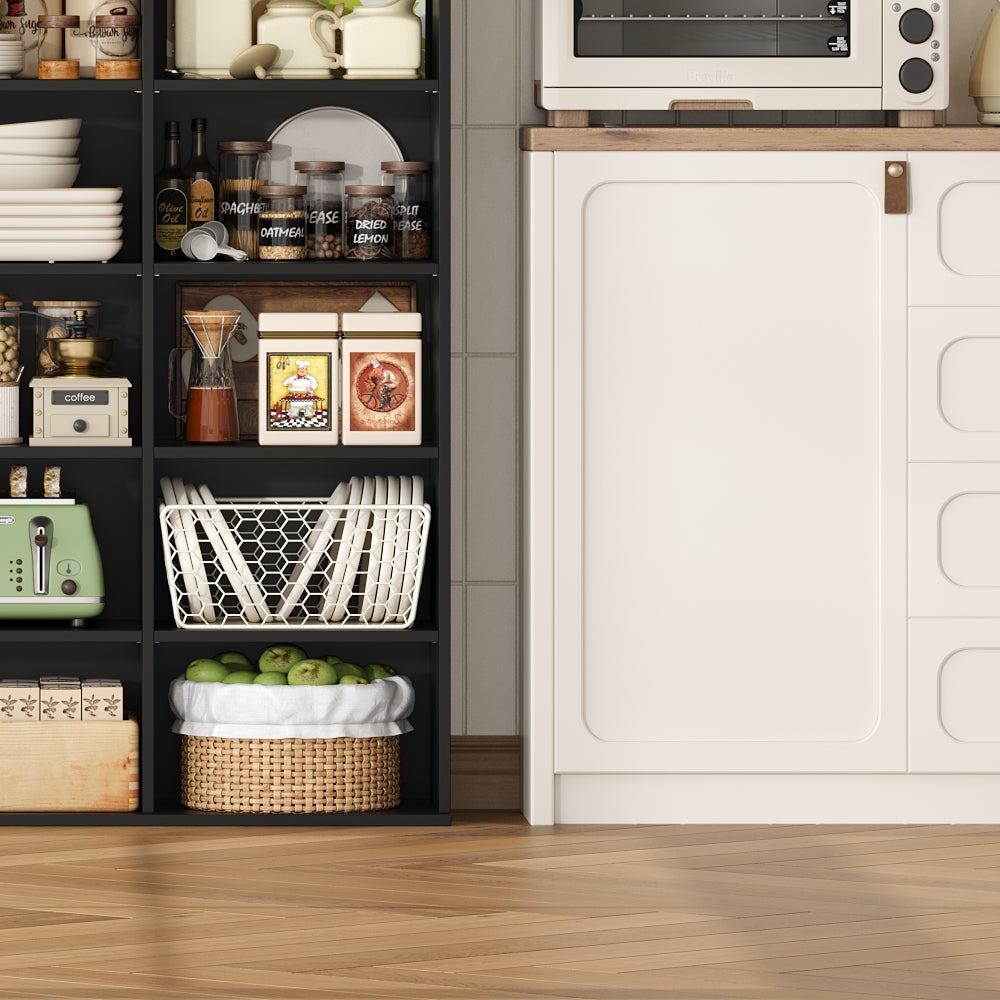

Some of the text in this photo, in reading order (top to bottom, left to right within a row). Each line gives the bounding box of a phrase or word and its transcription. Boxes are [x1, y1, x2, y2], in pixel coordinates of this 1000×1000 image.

[159, 202, 184, 213] Olive
[162, 213, 179, 224] Oil
[194, 208, 208, 220] Oil
[355, 220, 387, 230] DRIED
[261, 227, 305, 238] OATMEAL
[353, 233, 389, 244] LEMON
[65, 392, 96, 402] coffee
